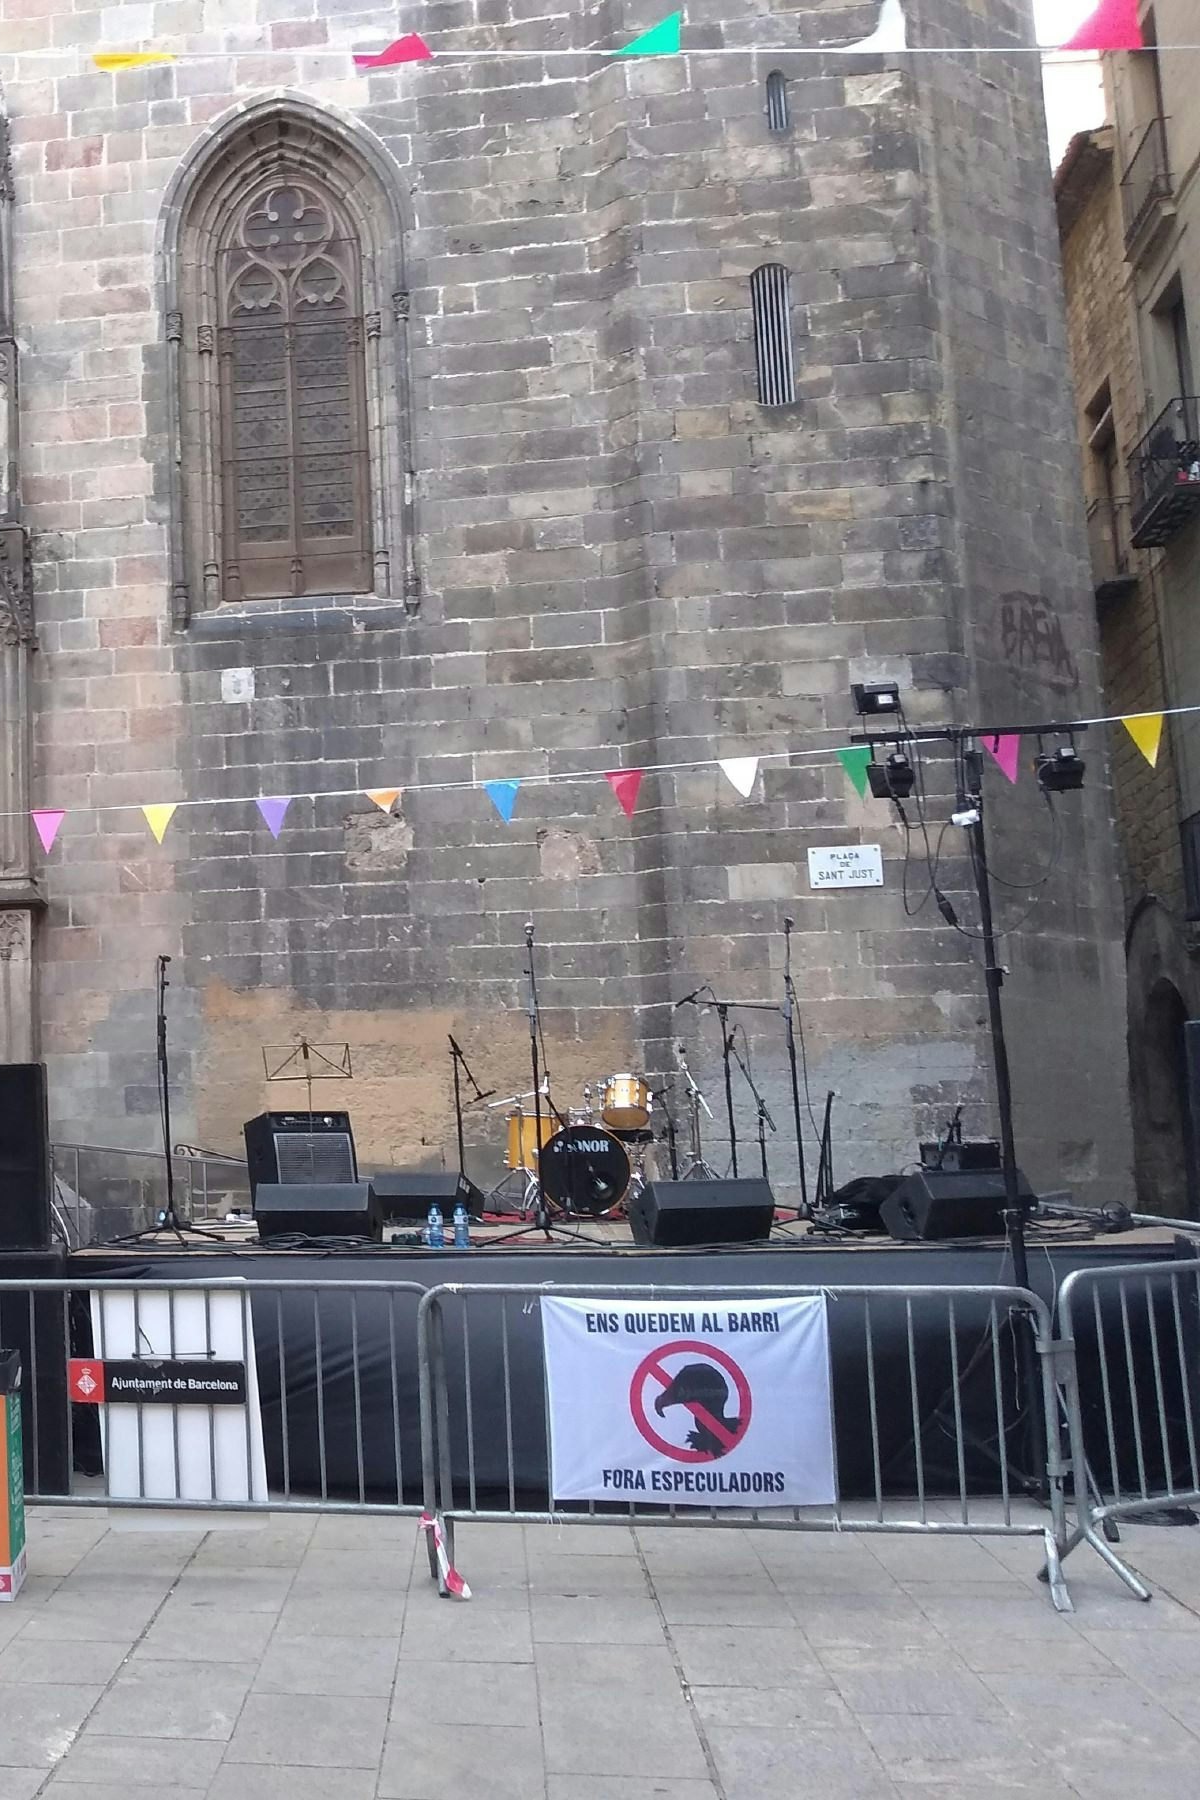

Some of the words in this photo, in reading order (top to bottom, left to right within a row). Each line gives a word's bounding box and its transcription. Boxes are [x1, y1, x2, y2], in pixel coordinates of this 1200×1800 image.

[818, 870, 845, 881] SANT
[848, 868, 875, 879] JUST
[585, 1312, 619, 1333] ENS
[624, 1312, 696, 1333] QUEDEM
[701, 1312, 723, 1333] AL
[728, 1312, 780, 1333] BARRI
[111, 1376, 173, 1390] Ajuntament
[173, 1377, 187, 1390] de
[188, 1378, 239, 1391] Barcelona
[602, 1468, 646, 1490] FORA
[651, 1470, 785, 1492] ESPECULADORS
